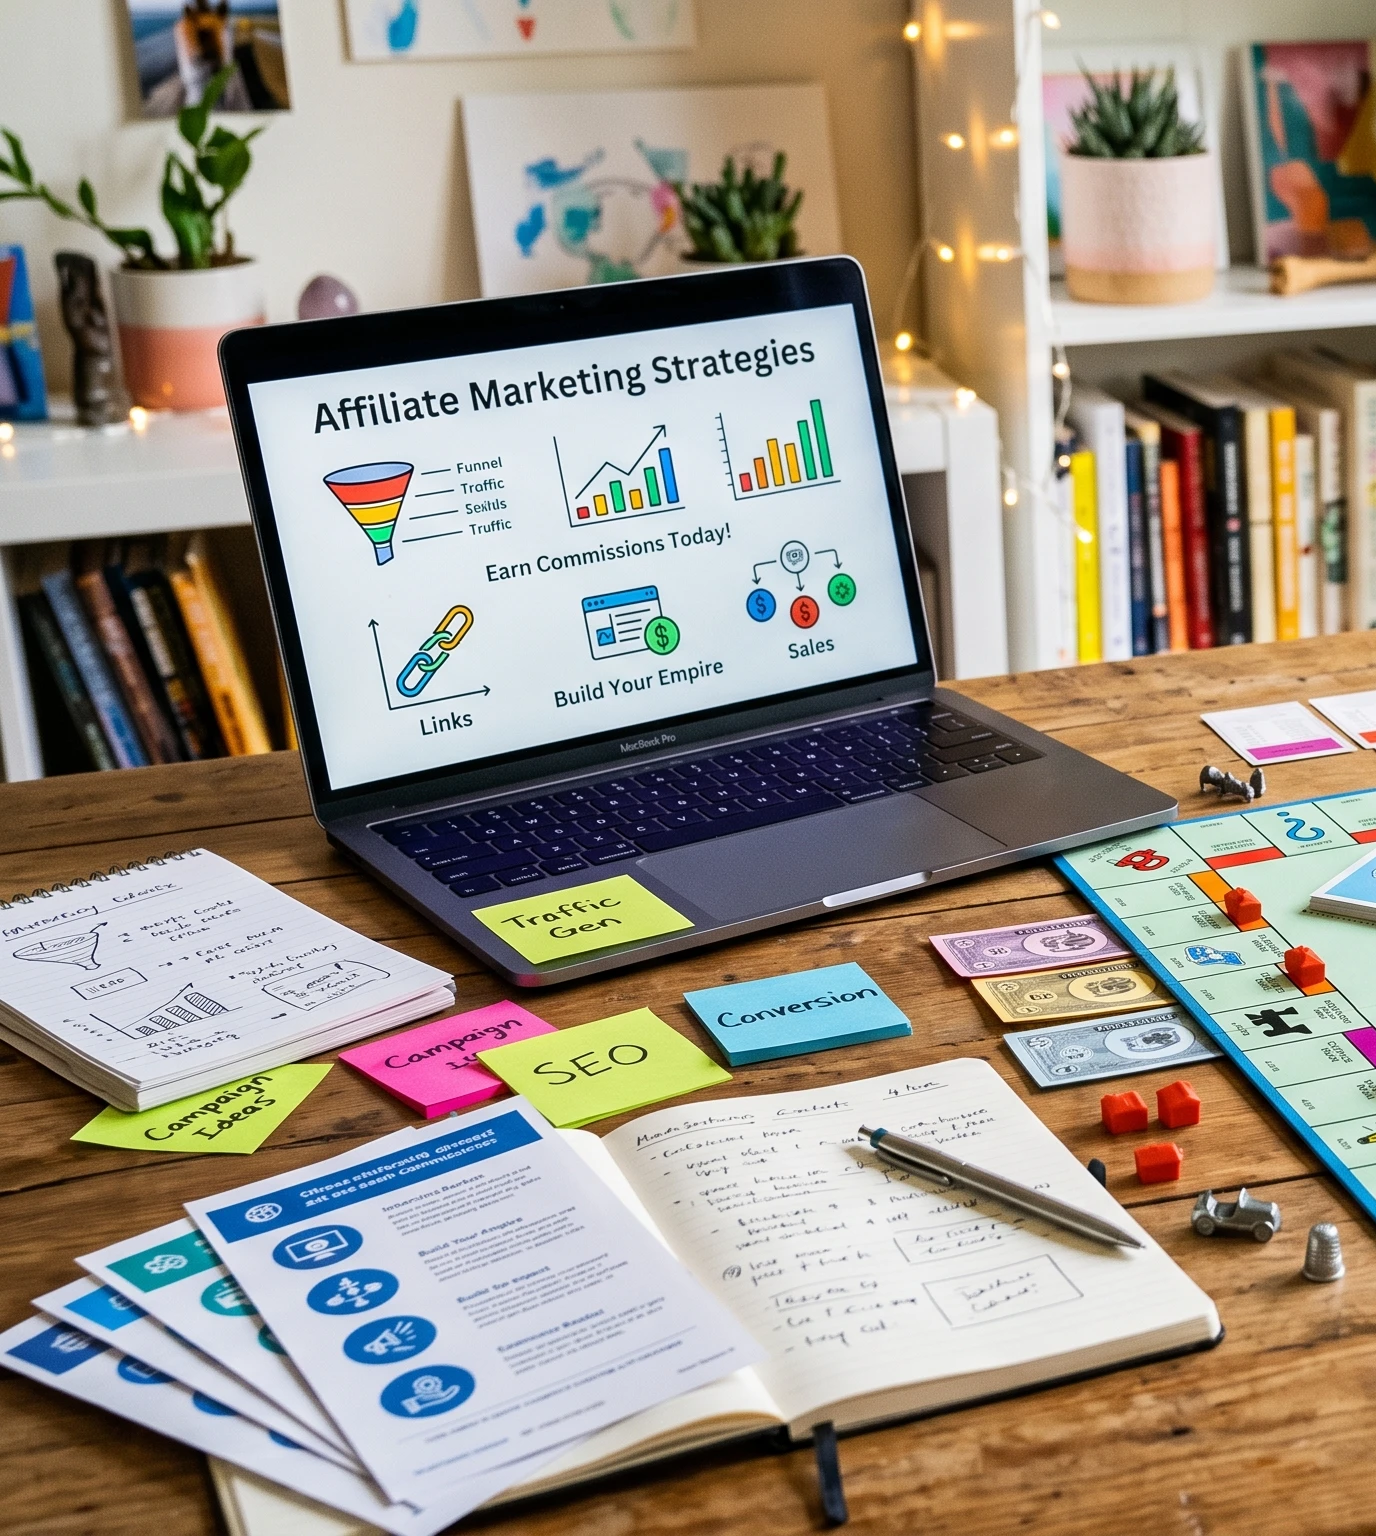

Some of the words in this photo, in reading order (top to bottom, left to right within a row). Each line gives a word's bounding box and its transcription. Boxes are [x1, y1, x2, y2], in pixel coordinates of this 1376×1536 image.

[314, 391, 460, 434] Affiliate
[469, 363, 646, 411] Marketing
[652, 339, 816, 384] Strategies
[456, 456, 503, 474] Funnel
[460, 478, 505, 494] Traffic
[469, 519, 512, 535] Truffic
[485, 561, 532, 582] Earn
[536, 537, 665, 573] Commissions
[668, 522, 732, 550] Today!
[788, 638, 835, 659] Sales
[554, 682, 605, 708] Build
[609, 674, 653, 697] Your
[658, 660, 724, 687] Empire
[420, 711, 473, 736] Links
[501, 895, 622, 929] Traffic
[549, 915, 622, 940] Gen
[717, 987, 879, 1029] Conversion
[384, 1019, 523, 1069] Campaign
[533, 1043, 649, 1086] SEO
[144, 1075, 274, 1141] Campaign
[191, 1094, 277, 1140] Ideas
